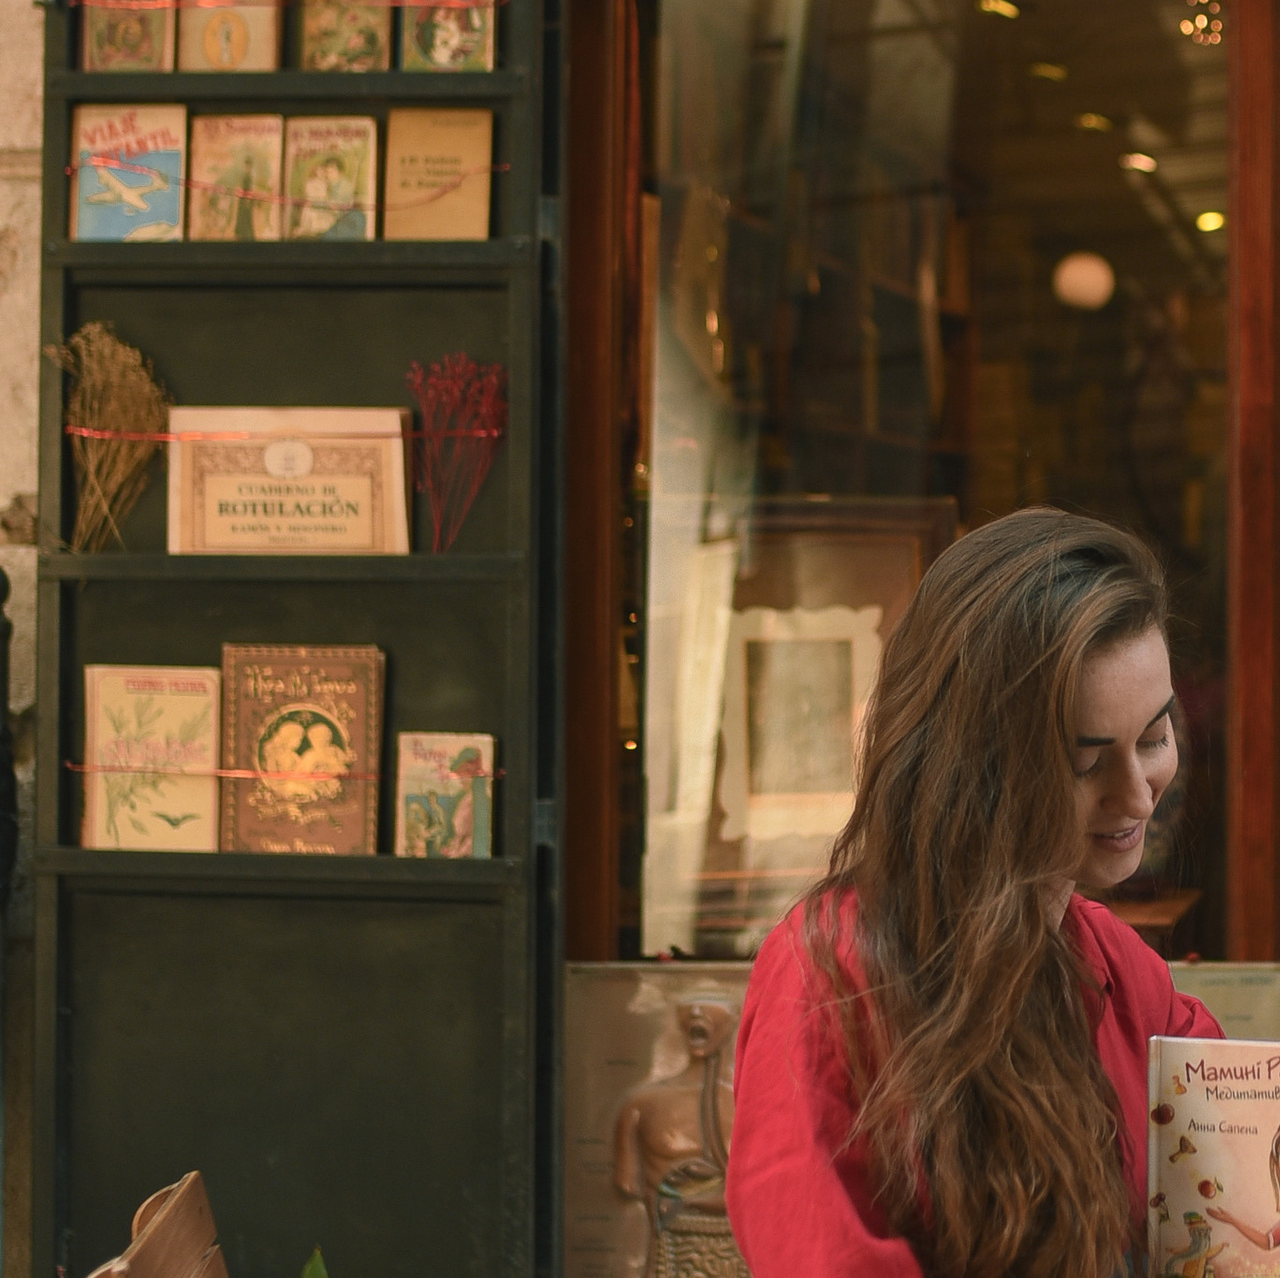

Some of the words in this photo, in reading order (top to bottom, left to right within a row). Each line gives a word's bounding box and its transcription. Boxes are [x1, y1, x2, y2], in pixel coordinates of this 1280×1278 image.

[217, 495, 360, 519] ROTULACIÓN
[1185, 1058, 1262, 1083] Мамині
[1188, 1118, 1216, 1133] Анна
[1218, 1120, 1258, 1135] Сапена
